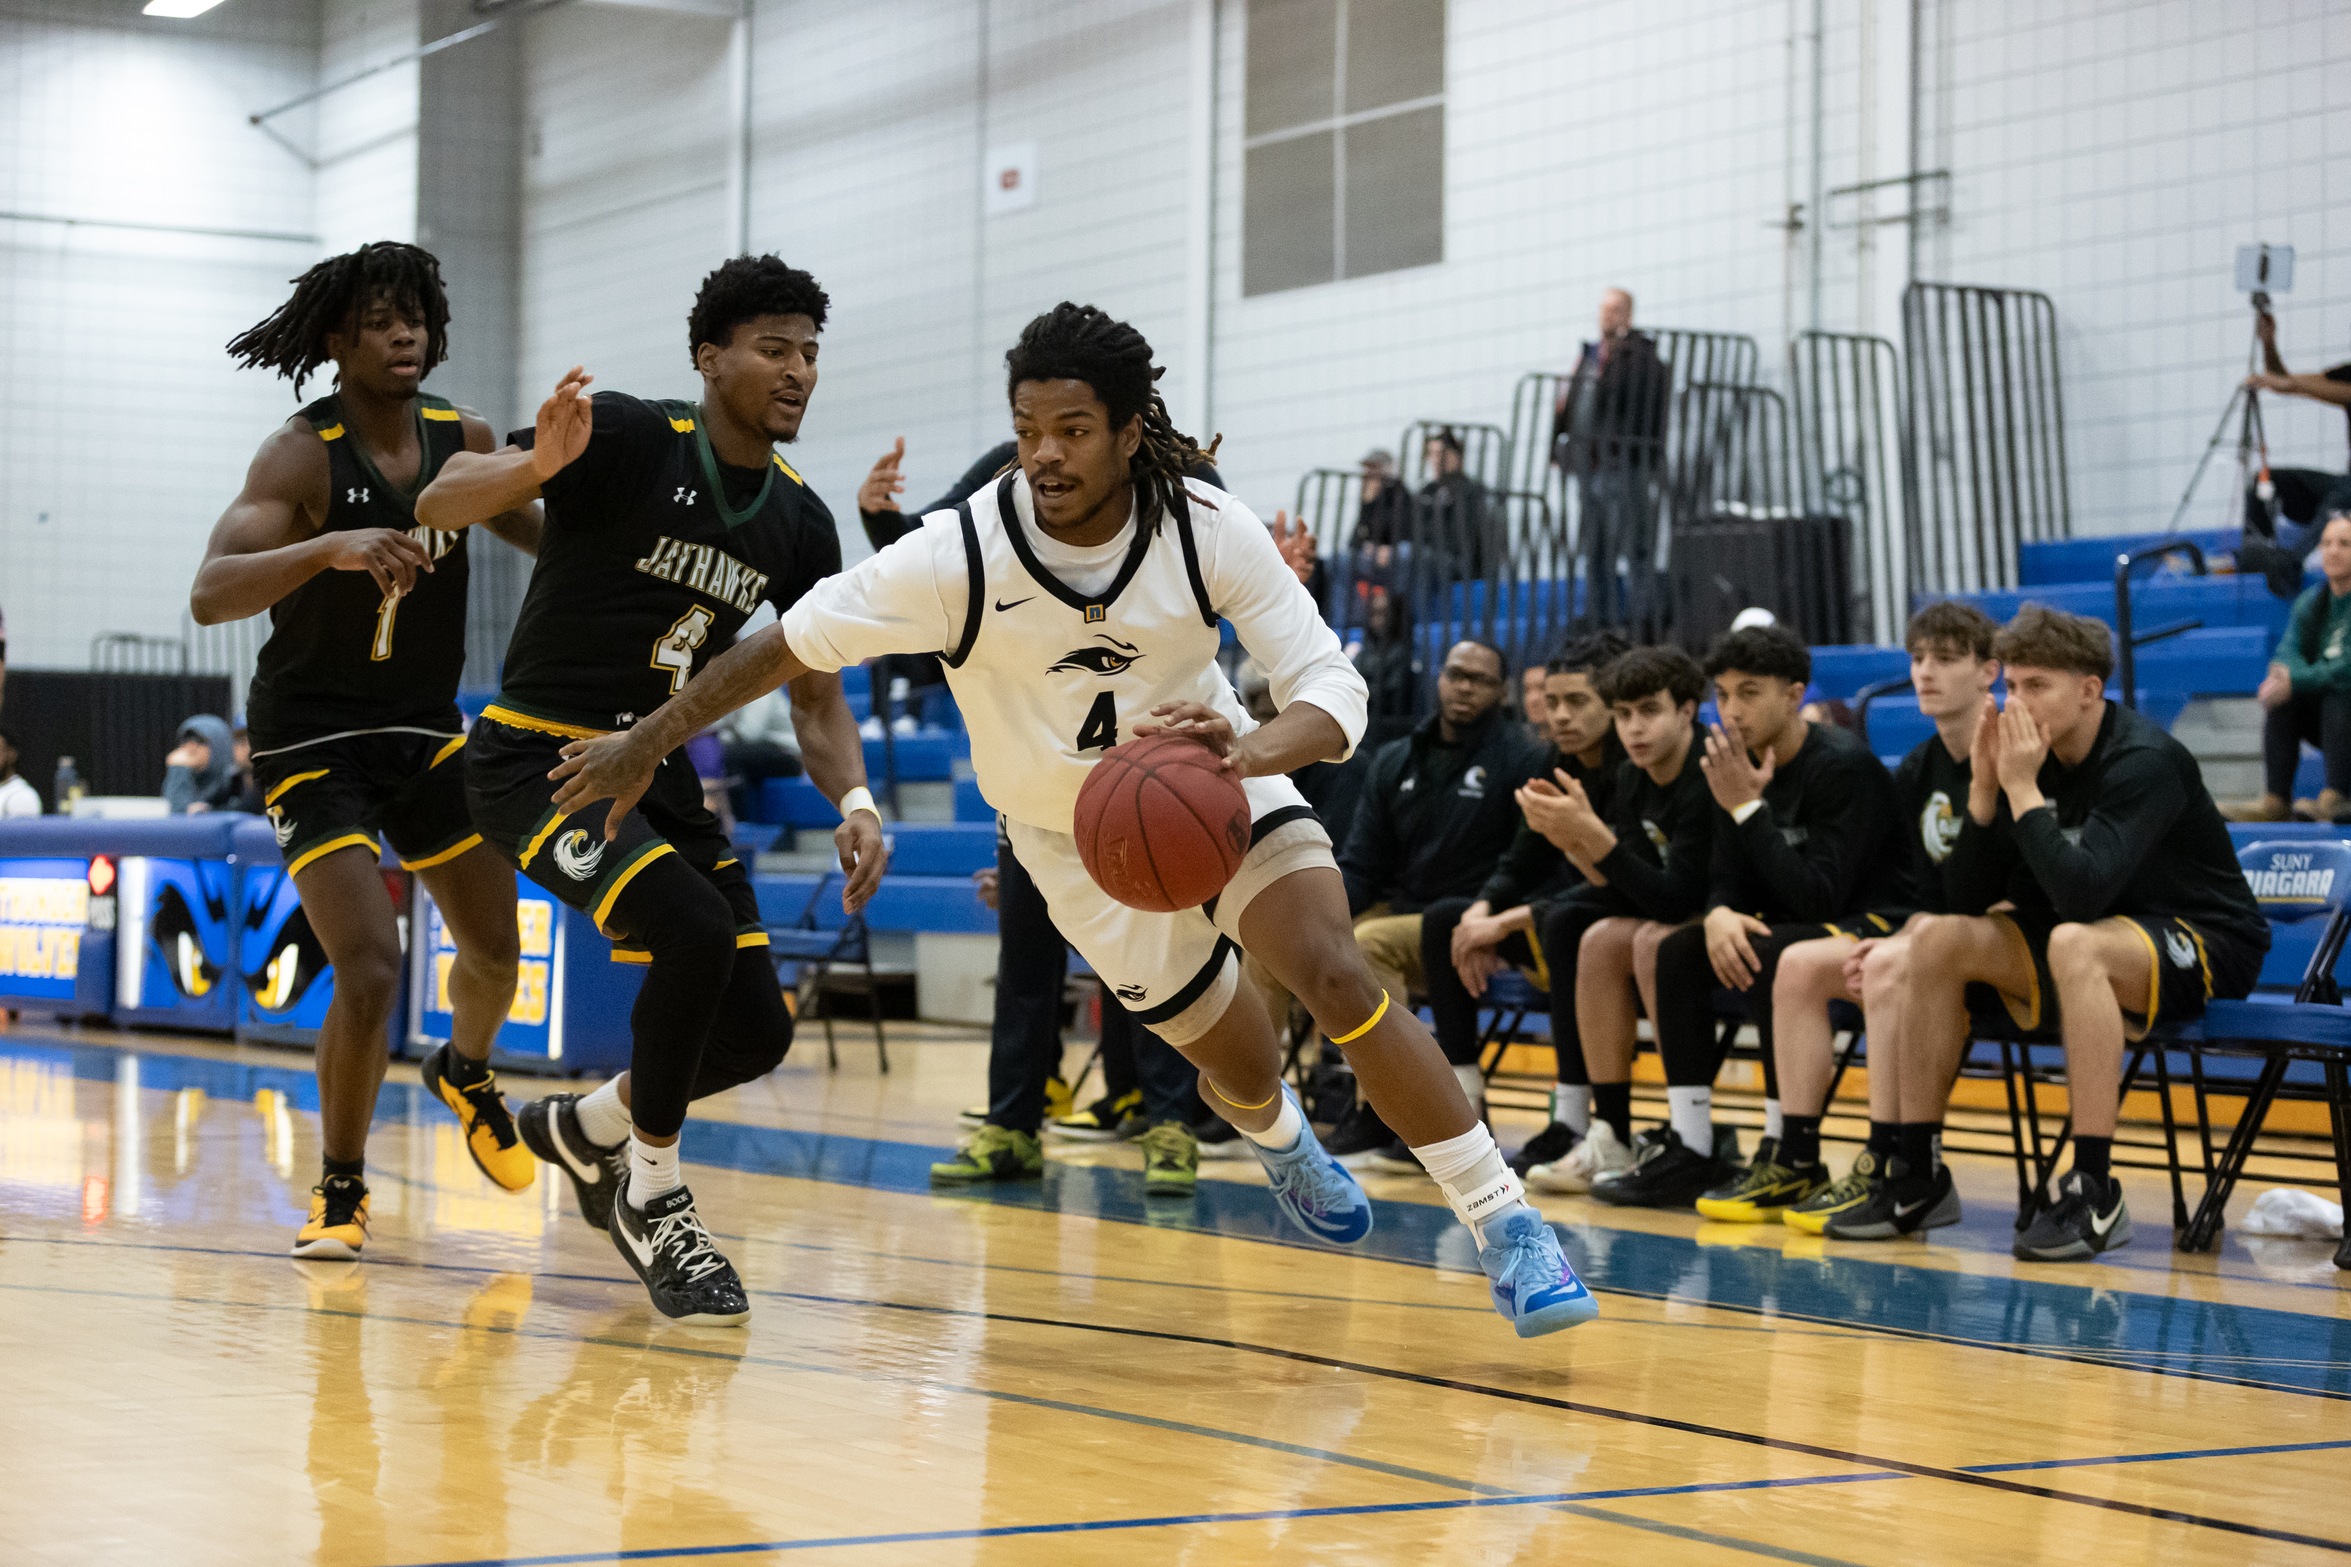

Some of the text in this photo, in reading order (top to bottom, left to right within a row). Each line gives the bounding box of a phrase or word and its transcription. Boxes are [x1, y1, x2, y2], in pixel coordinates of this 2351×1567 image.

[634, 535, 769, 615] JAYHAWKS
[650, 603, 716, 695] 4
[1076, 690, 1118, 751] 4
[2270, 853, 2313, 870] SUNY
